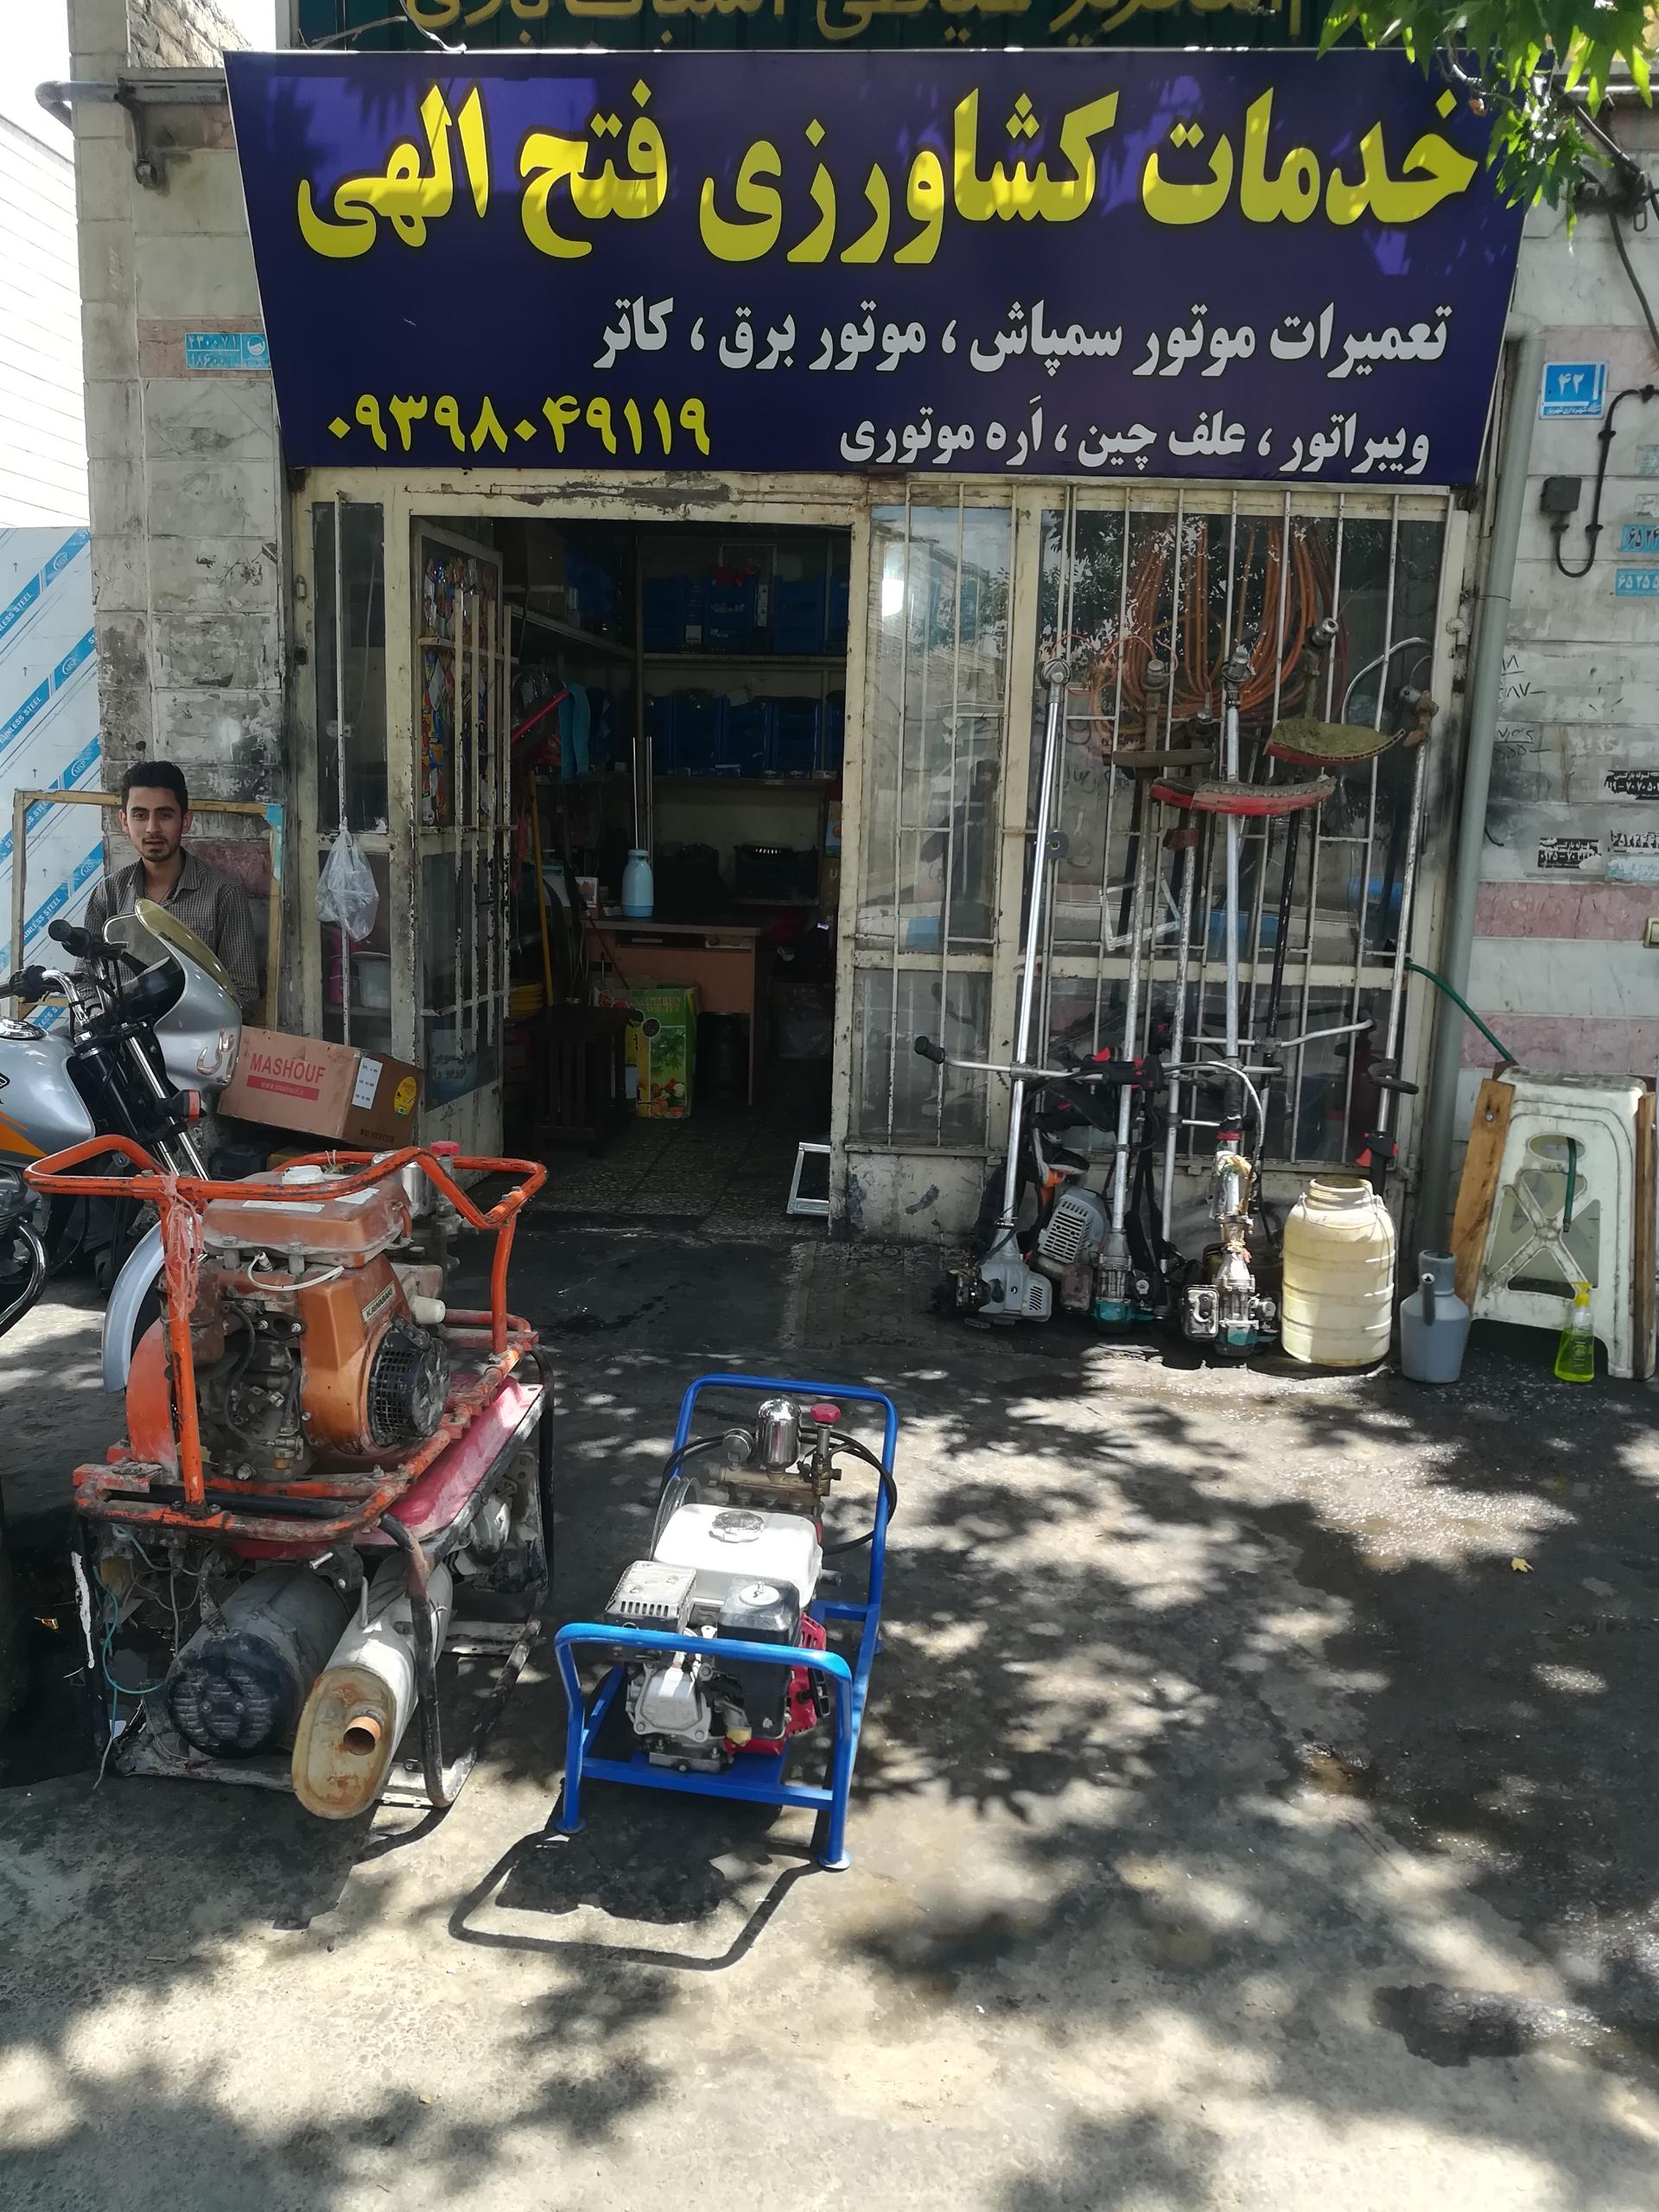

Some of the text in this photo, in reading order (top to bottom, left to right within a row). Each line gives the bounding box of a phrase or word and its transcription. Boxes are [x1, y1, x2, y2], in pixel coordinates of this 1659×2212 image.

[298, 79, 1478, 264] خدمات کشاورزی فتح الهی
[594, 296, 675, 369] کاتر
[720, 307, 797, 371] برق
[810, 301, 927, 372] موتور
[969, 299, 1123, 378] سمپاش
[1133, 304, 1257, 378] موتور
[1269, 302, 1453, 379] تعمیرات
[330, 395, 712, 455] ۰۹۳۹۸۰۴۹۱۱۹
[840, 407, 976, 466] موتوری
[1077, 423, 1159, 472] چین
[1168, 410, 1247, 458] علف
[1279, 412, 1431, 474] ویبراتور
[15, 593, 33, 613] STEEL
[23, 696, 41, 716] STEEL
[43, 897, 61, 916] STEEL
[249, 1052, 325, 1084] MASHOUF
[365, 1286, 393, 1319] KAWASAKI
